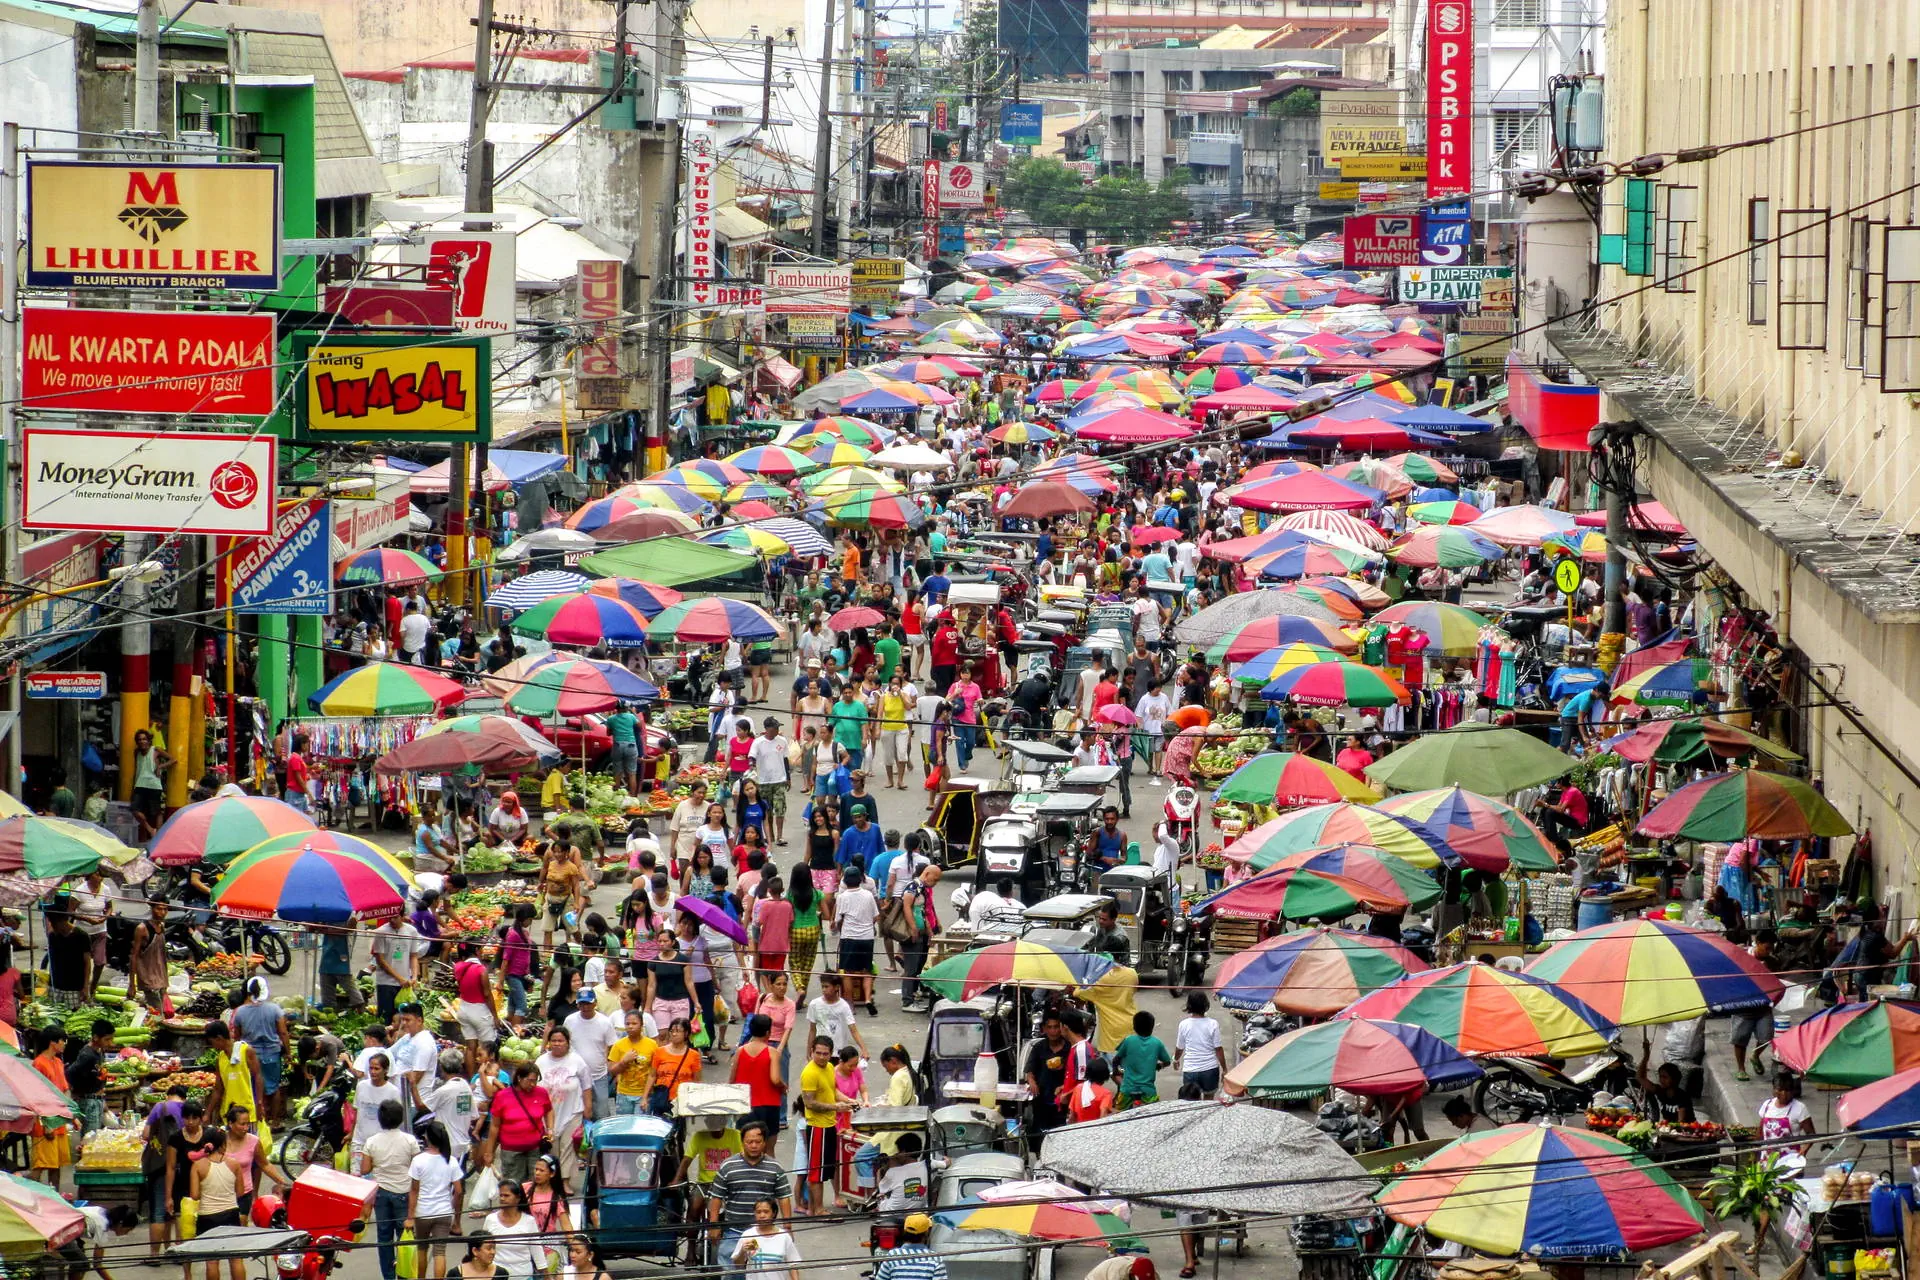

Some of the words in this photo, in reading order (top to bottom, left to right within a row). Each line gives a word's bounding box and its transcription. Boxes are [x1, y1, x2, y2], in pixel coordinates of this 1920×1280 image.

[1439, 42, 1459, 178] PSBank
[1330, 130, 1355, 141] NEW
[1369, 130, 1401, 141] HOTEL
[1330, 141, 1401, 151] ENTRANCE
[125, 171, 181, 206] M
[943, 189, 981, 199] HORTALEZA
[1379, 219, 1409, 234] VP
[1433, 223, 1465, 244] ATM
[45, 246, 261, 272] LHUILLIER
[73, 275, 167, 287] BLUMENTRITT
[170, 276, 226, 288] BRANCH
[767, 269, 849, 292] Tambunting
[28, 333, 61, 361] ML
[69, 335, 169, 365] KWARTA
[178, 337, 268, 368] PADALA
[318, 351, 364, 370] Mang
[41, 367, 66, 387] We
[70, 370, 113, 388] move
[116, 374, 151, 393] your
[154, 375, 207, 395] money
[315, 360, 468, 419] INASAL
[37, 460, 196, 490] MoneyGram
[75, 489, 133, 501] International
[134, 492, 165, 503] Money
[166, 492, 203, 503] Transfer
[1280, 502, 1336, 510] MICROMATIC
[239, 518, 321, 606] PAWNSHOP
[291, 569, 326, 599] 3%
[56, 685, 100, 694] PAWNSHOP
[1301, 694, 1340, 705] MICROMATIC
[229, 908, 272, 919] MICROMATIC
[364, 904, 403, 919] MICROMATIC
[1225, 908, 1272, 919] MICROMATIC
[1545, 1243, 1617, 1256] MICROMATIC
